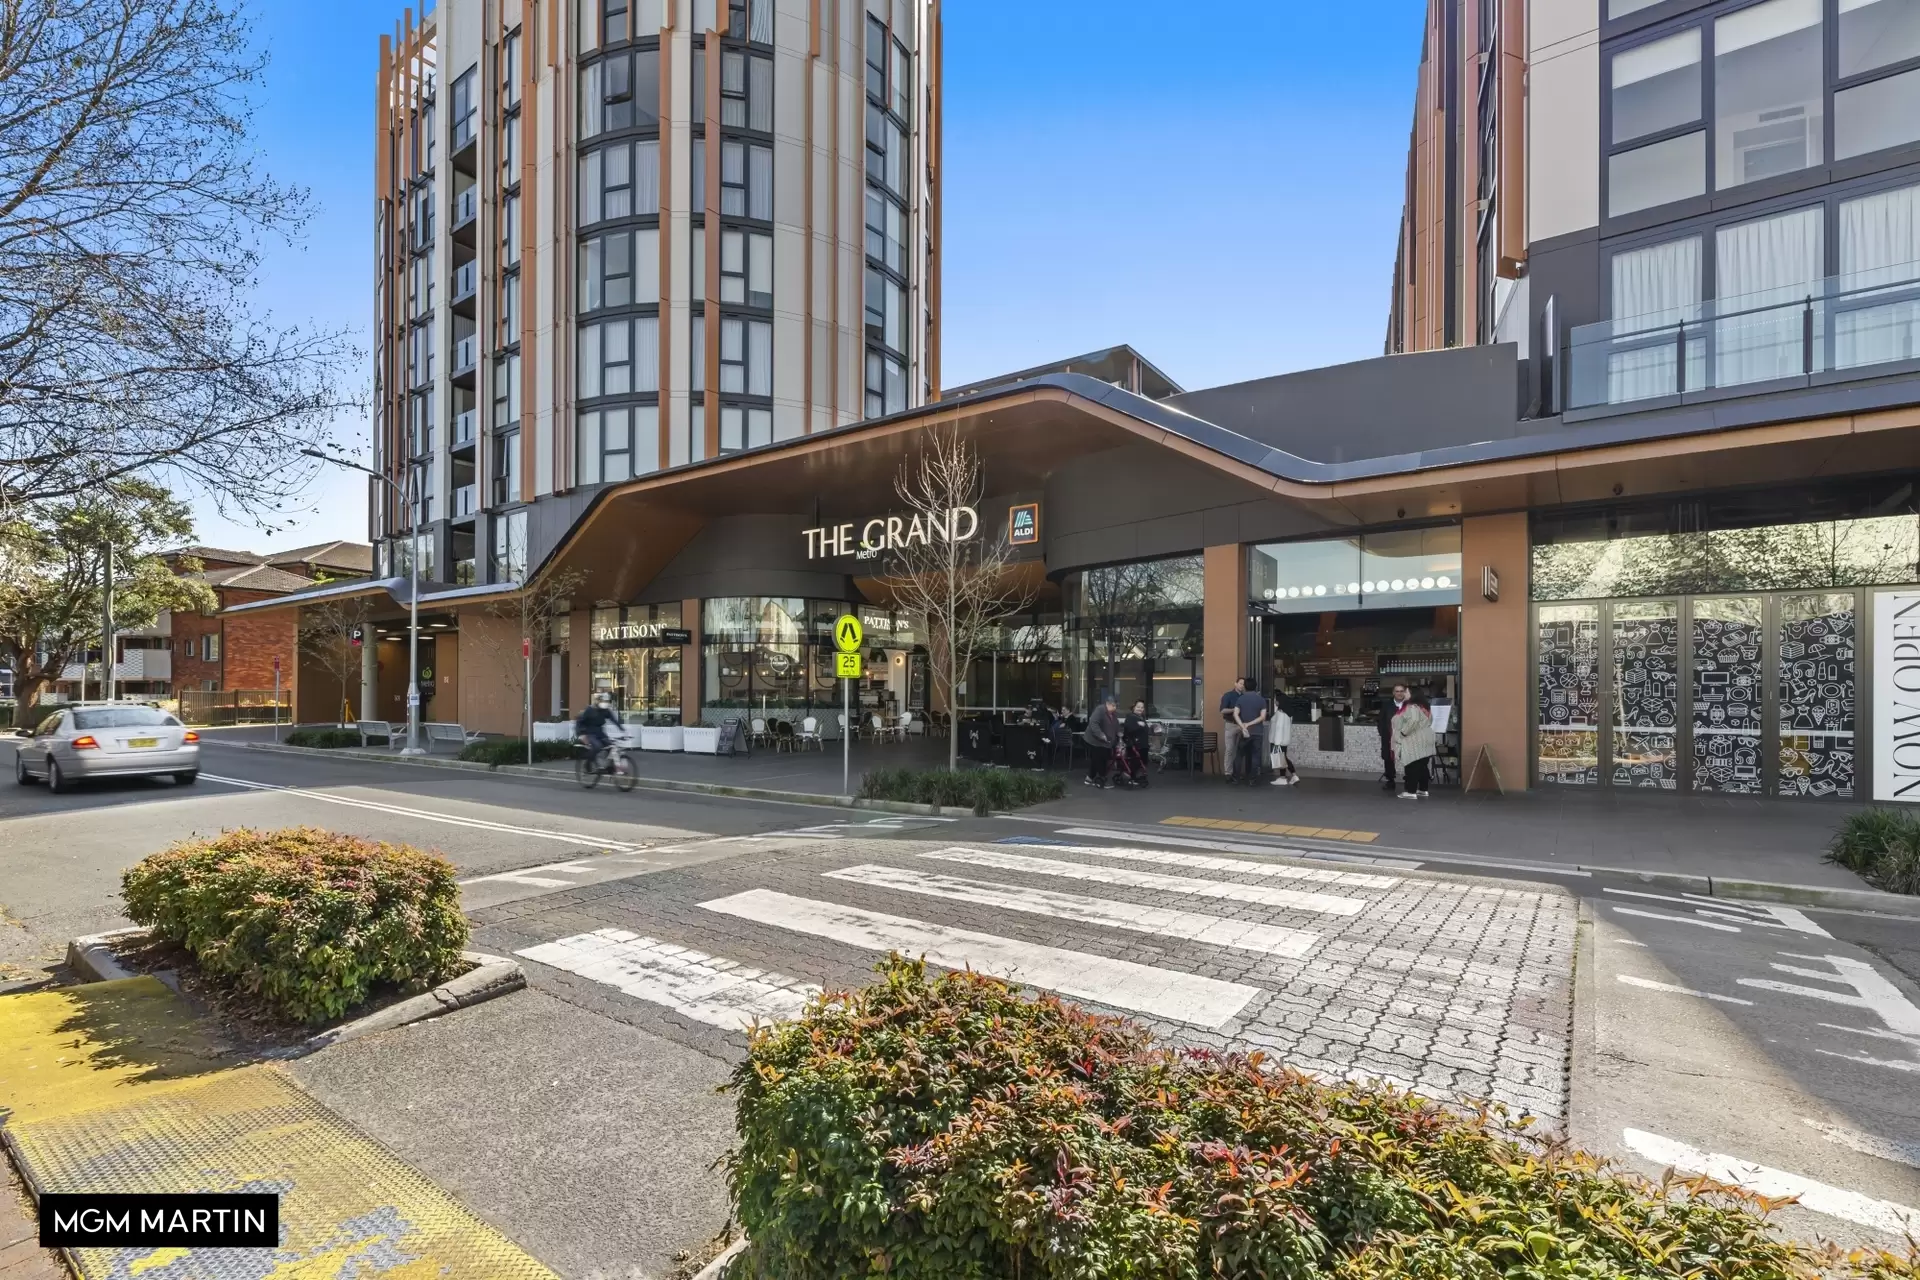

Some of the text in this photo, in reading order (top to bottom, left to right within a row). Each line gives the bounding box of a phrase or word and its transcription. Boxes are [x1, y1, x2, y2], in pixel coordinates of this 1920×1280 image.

[802, 507, 978, 559] THE GRAND
[1014, 528, 1033, 537] ALDI
[856, 549, 877, 560] Metro
[353, 630, 361, 638] P
[843, 655, 856, 668] 25
